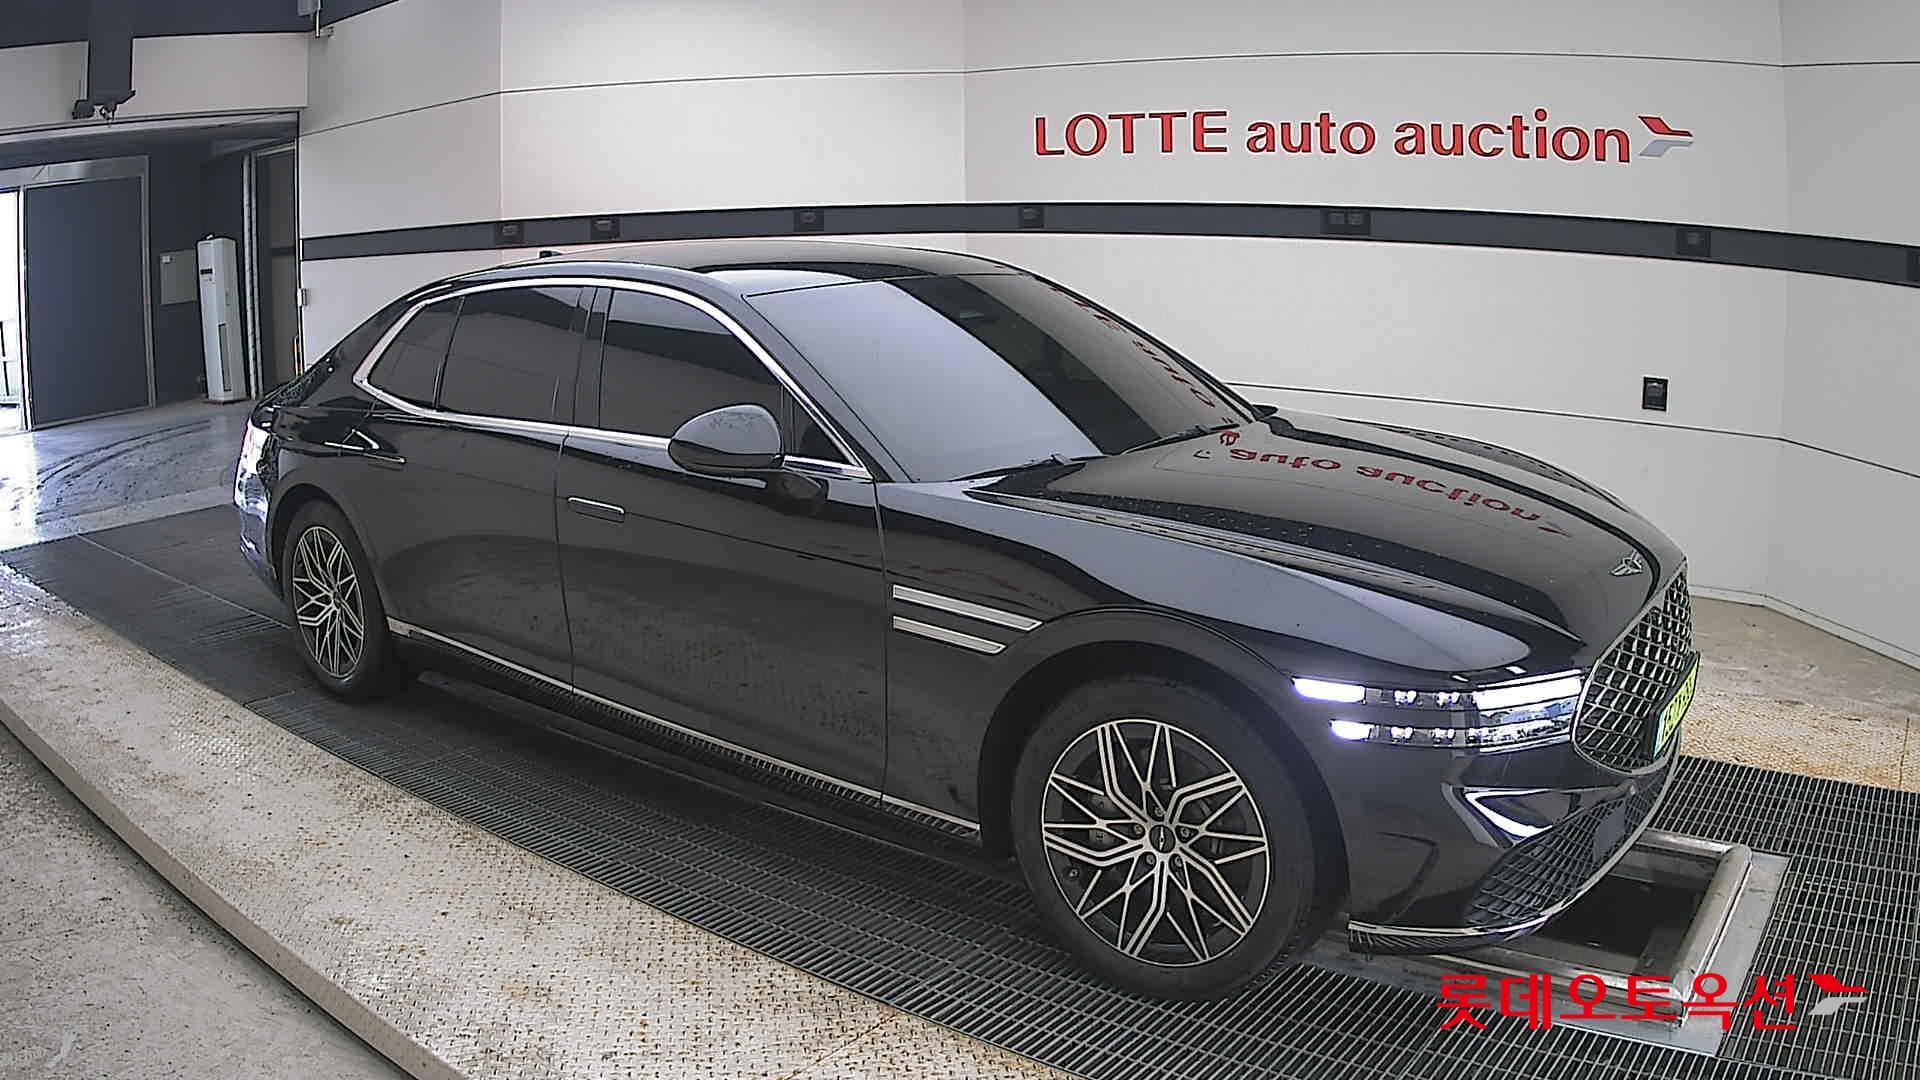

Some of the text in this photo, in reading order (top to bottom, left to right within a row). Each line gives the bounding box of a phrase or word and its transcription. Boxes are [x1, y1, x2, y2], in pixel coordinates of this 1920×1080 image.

[1034, 107, 1631, 164] LOTTE auto auction
